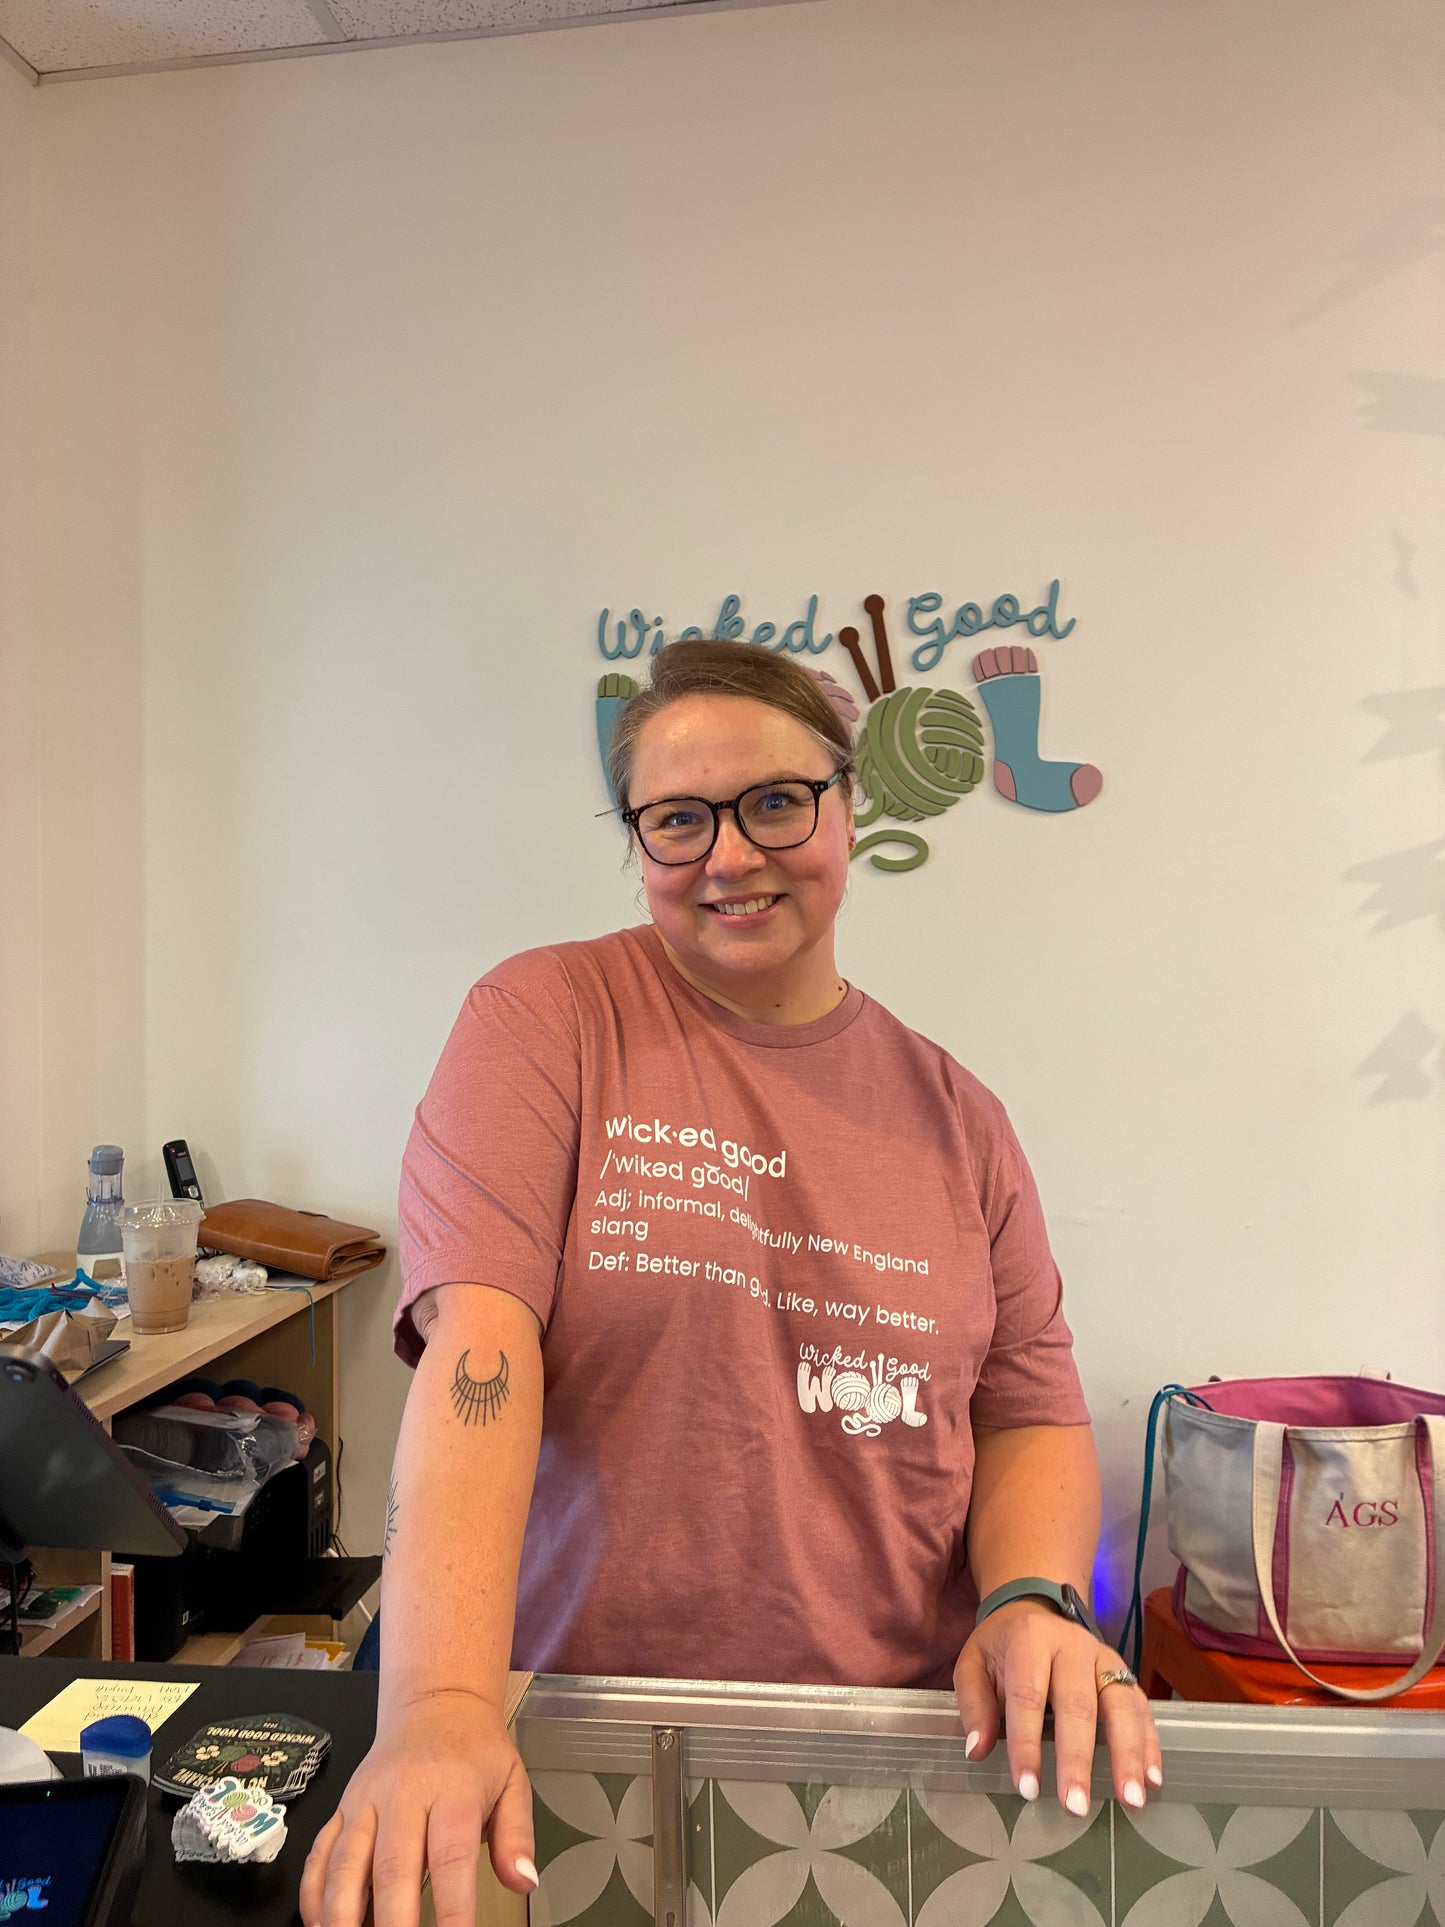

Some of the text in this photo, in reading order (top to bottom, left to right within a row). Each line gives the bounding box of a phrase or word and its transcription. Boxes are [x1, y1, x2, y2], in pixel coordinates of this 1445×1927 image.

[907, 579, 1077, 671] Good
[721, 1140, 786, 1178] good
[590, 1216, 649, 1241] slang
[594, 1188, 632, 1212] Adj;
[638, 1189, 726, 1222] informal,
[807, 1233, 849, 1256] New
[853, 1244, 929, 1276] England
[588, 1251, 630, 1272] Def:
[635, 1252, 701, 1277] Better
[705, 1261, 746, 1288] than
[777, 1291, 819, 1317] Like,
[824, 1300, 871, 1327] way
[876, 1304, 940, 1335] better.
[799, 1342, 932, 1382] Wicked Good
[1324, 1500, 1399, 1528] AGS
[206, 1726, 316, 1745] WICKED GOOD WOOL
